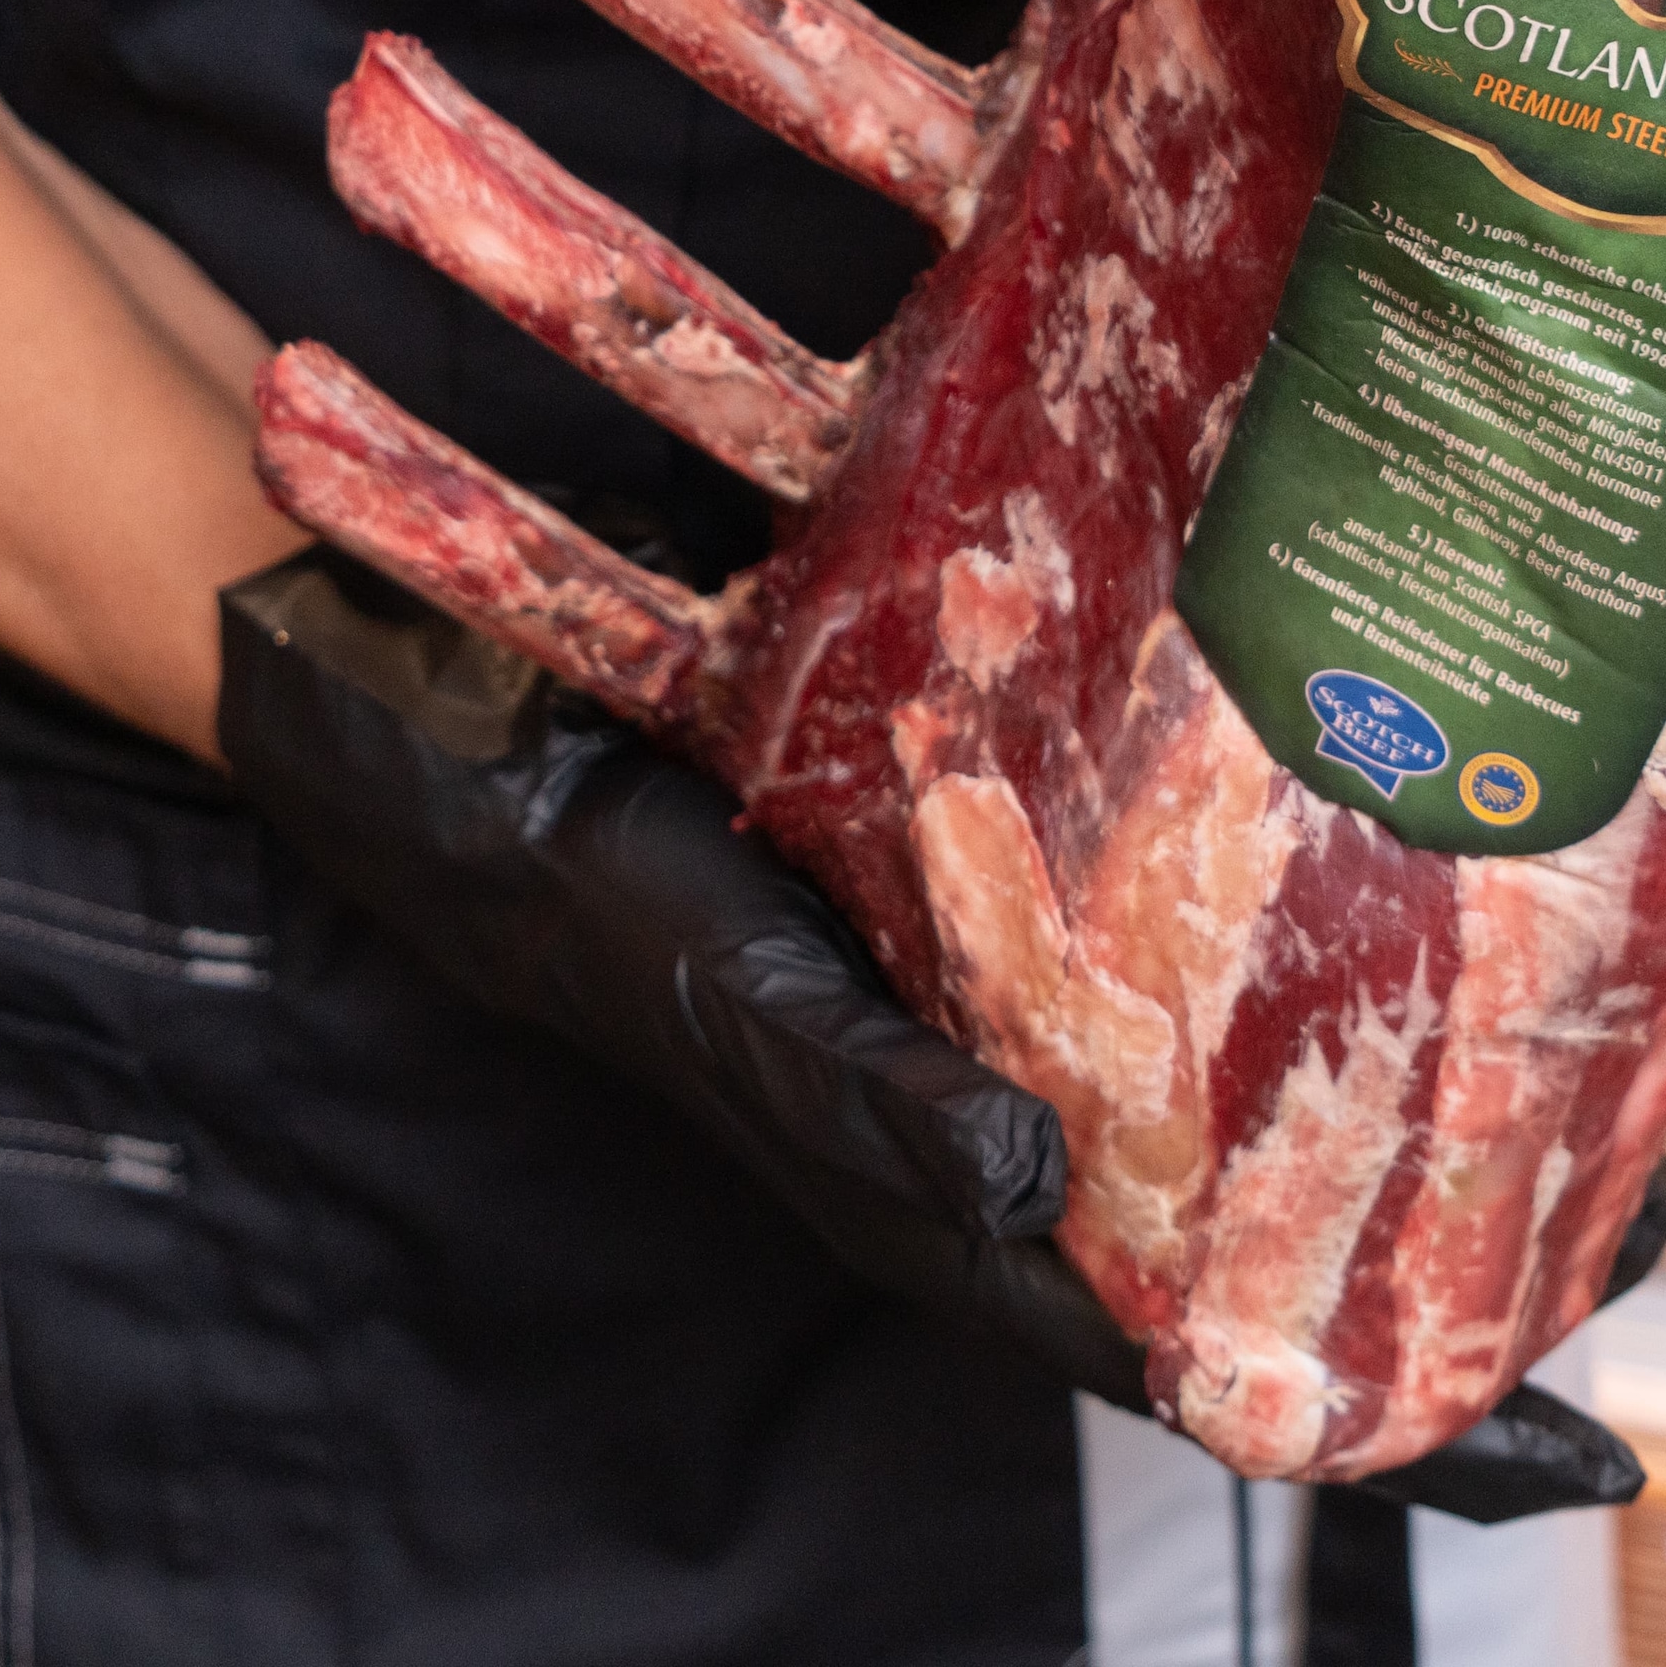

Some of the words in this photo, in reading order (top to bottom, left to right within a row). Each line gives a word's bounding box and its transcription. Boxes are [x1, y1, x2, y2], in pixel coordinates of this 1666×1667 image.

[1473, 73, 1603, 133] PREMIUM
[1371, 200, 1392, 224] 2.)
[1395, 216, 1439, 248] Erstes
[1441, 245, 1540, 287] geografisch
[1542, 280, 1646, 336] geschütztes,
[1456, 212, 1478, 235] 1.)
[1483, 224, 1529, 248] 100%
[1532, 242, 1627, 288] schottische
[1357, 268, 1420, 314] während
[1421, 308, 1447, 330] des
[1452, 325, 1523, 373] gesamten
[1527, 363, 1662, 432] Lebenszeitraums
[1372, 299, 1468, 360] unabhängige
[1471, 353, 1545, 405] Kontrollen
[1549, 399, 1585, 426] aller
[1447, 302, 1470, 323] 3.)
[1474, 316, 1635, 395] Qualitätssicherung:
[1593, 323, 1627, 349] seit
[1357, 383, 1381, 408] 4.)
[1382, 393, 1488, 463] Überwiegend
[1487, 453, 1640, 544] Mutterkuhhaltung:
[1375, 348, 1417, 384] keine
[1421, 377, 1582, 476] wachstumsfördernden
[1585, 466, 1663, 510] Hormone
[1381, 326, 1533, 421] Wertschöpfungskette
[1537, 415, 1590, 454] gemäß
[1591, 443, 1664, 485] EN45011
[1312, 401, 1401, 462] Traditionelle
[1403, 453, 1500, 523] Fleischrassen,
[1506, 514, 1534, 539] wie
[1535, 532, 1611, 581] Aberdeen
[1379, 464, 1446, 517] Highland,
[1452, 507, 1521, 559] Galloway,
[1525, 549, 1562, 580] Beef
[1562, 571, 1644, 620] Shorthorn
[1443, 453, 1543, 523] Grasfütterung
[1308, 520, 1396, 580] (schottische
[1398, 570, 1570, 679] Tierschutzorganisation)
[1343, 517, 1422, 568] anerkannt
[1423, 559, 1451, 585] von
[1452, 575, 1511, 619] Scottish
[1512, 609, 1552, 643] SPCA
[1407, 524, 1431, 549] 5.)
[1433, 537, 1506, 589] Tierwohl:
[1268, 542, 1291, 568] 6.)
[1292, 556, 1379, 616] Garantierte
[1381, 605, 1468, 664] Reifedauer
[1468, 653, 1495, 680] für
[1495, 671, 1582, 724] Barbecues
[1331, 606, 1365, 633] und
[1363, 622, 1492, 706] Bratenteilstücke
[1314, 685, 1436, 764] SCOTCH
[1331, 712, 1407, 762] BEEF
